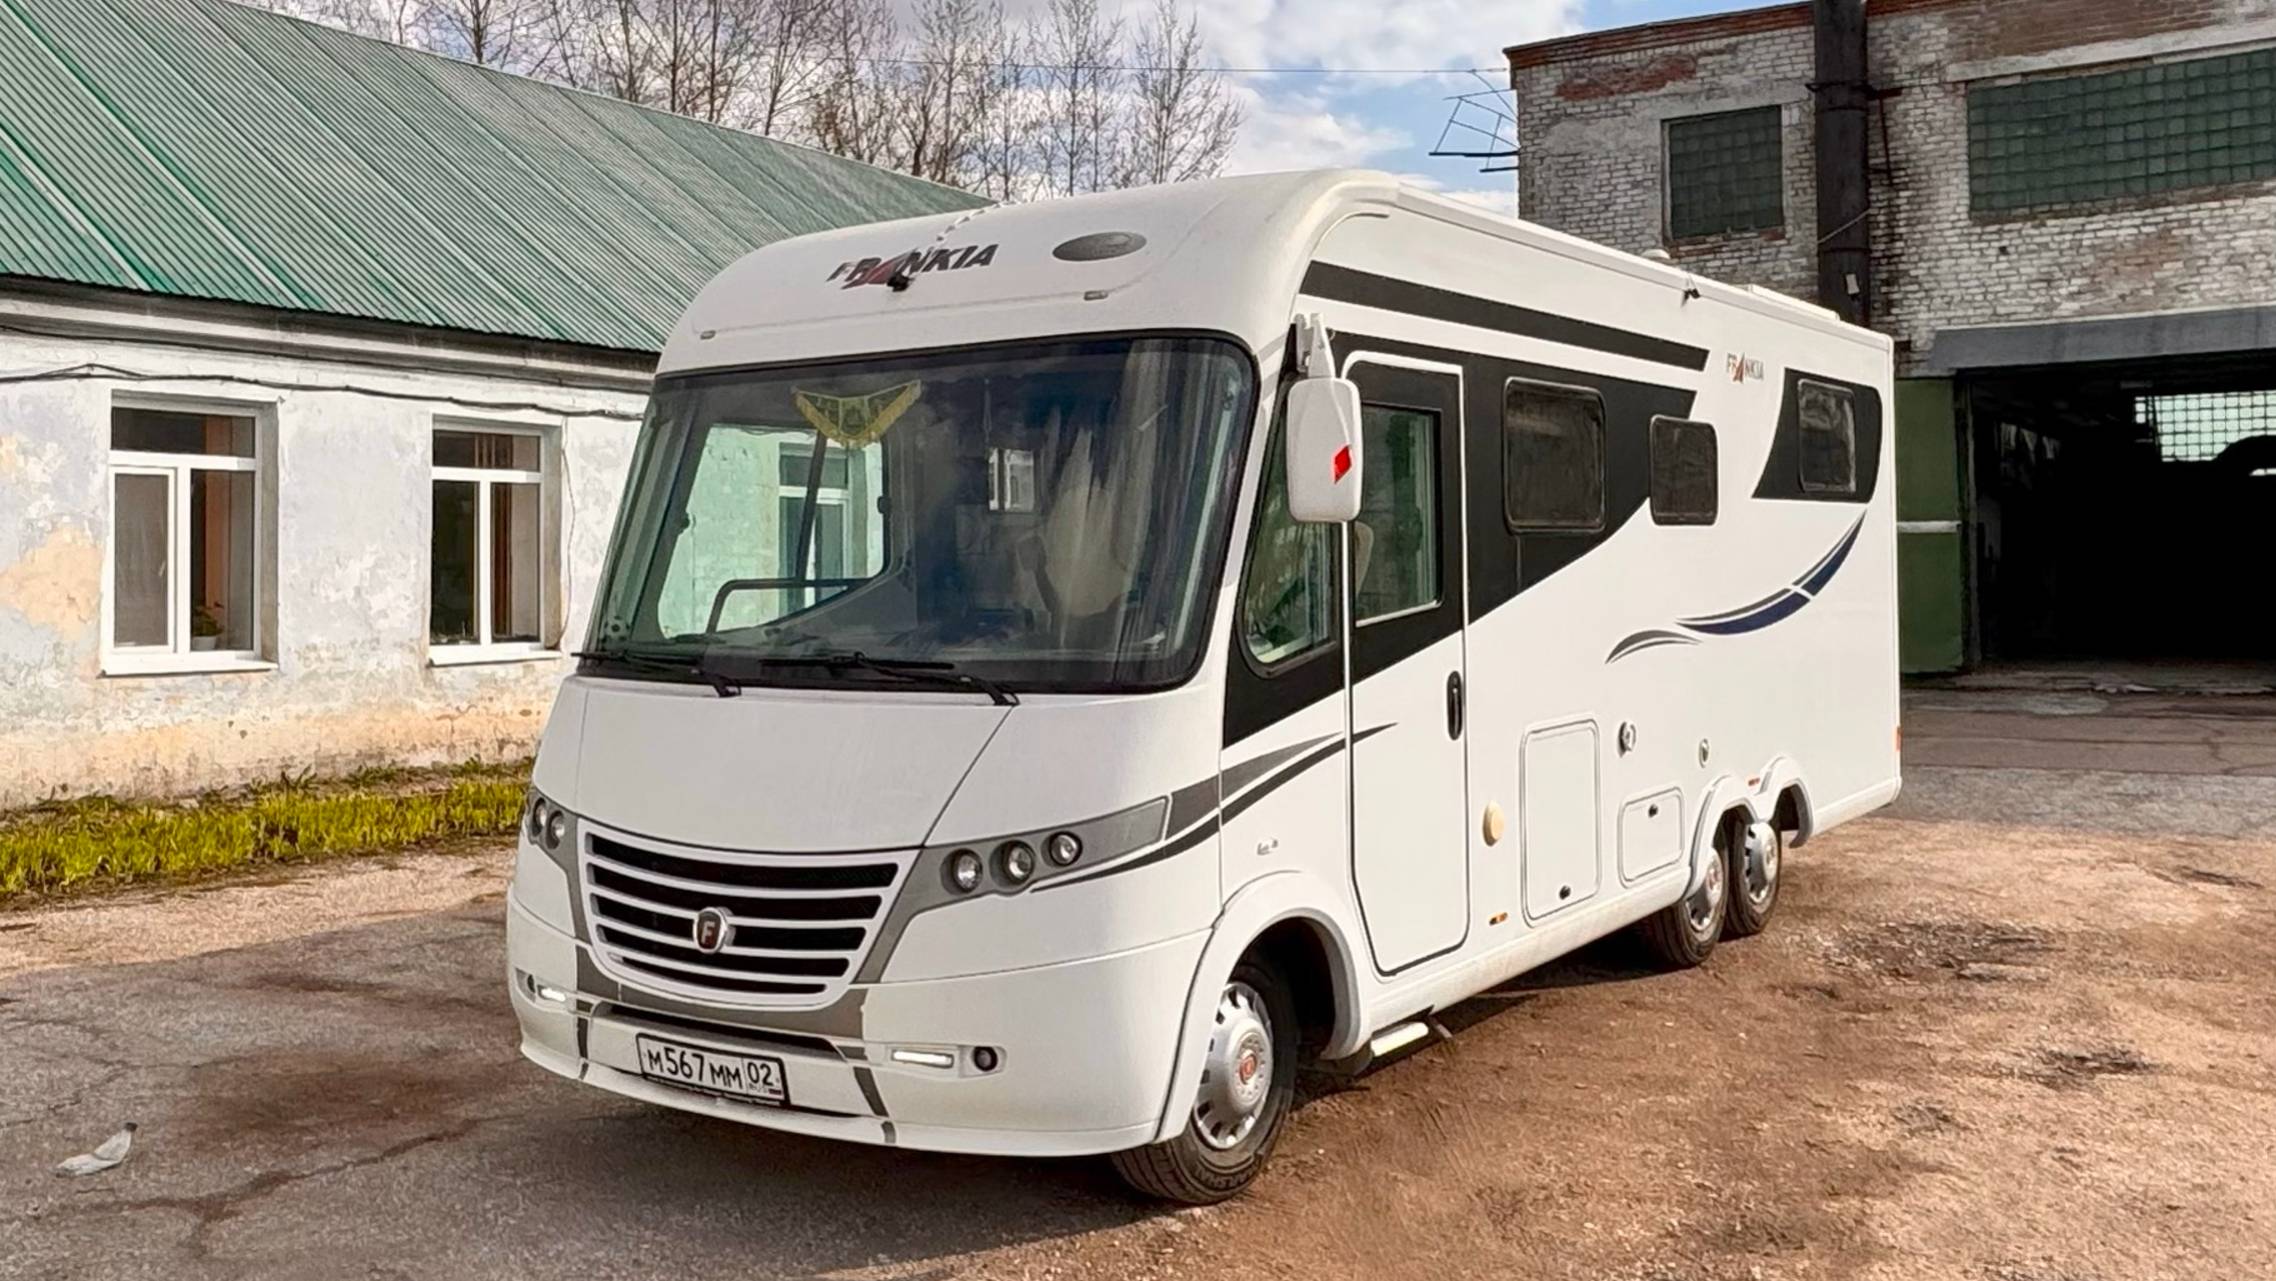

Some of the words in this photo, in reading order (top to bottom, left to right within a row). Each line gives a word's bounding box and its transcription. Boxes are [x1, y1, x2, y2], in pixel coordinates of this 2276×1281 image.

[827, 244, 999, 289] FRANKIA
[701, 921, 716, 944] F
[747, 1061, 774, 1087] 02
